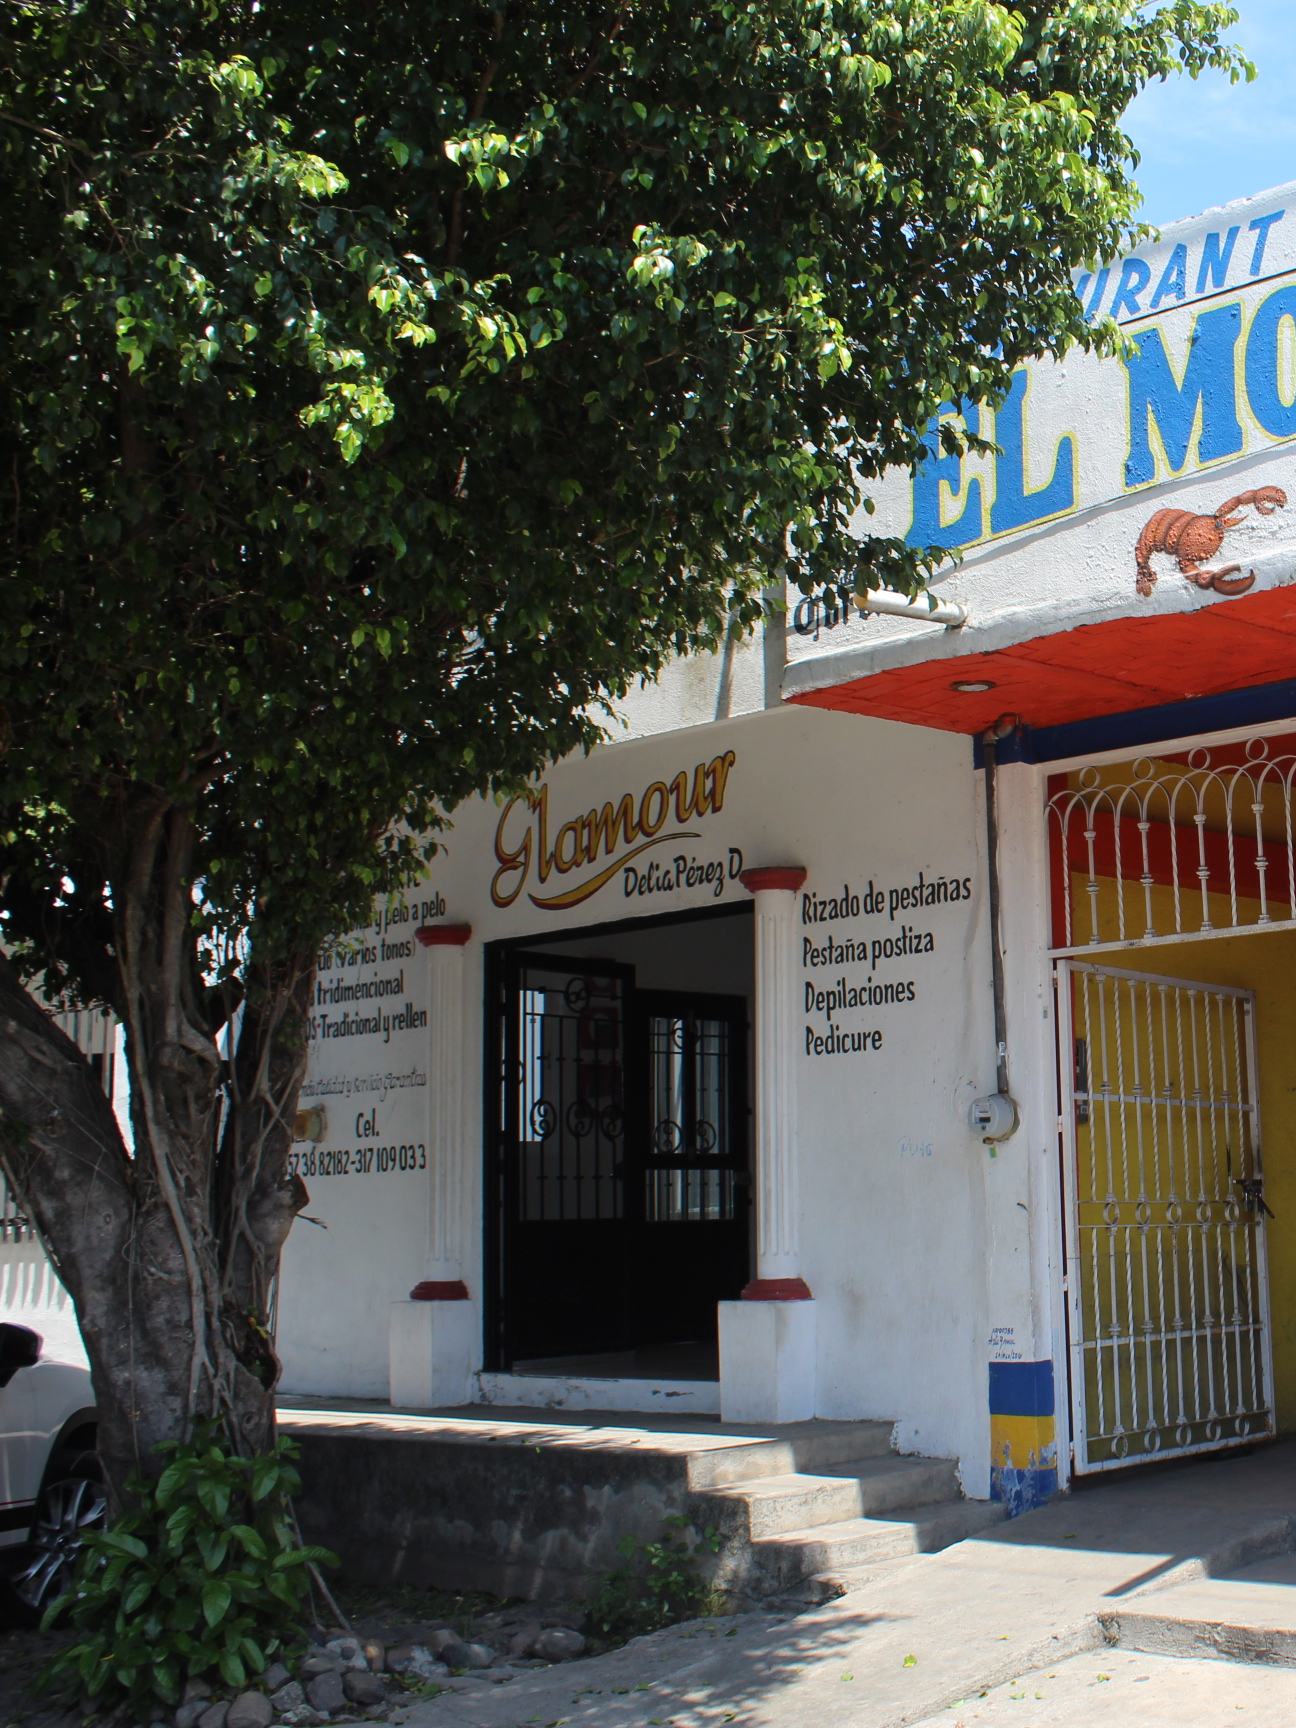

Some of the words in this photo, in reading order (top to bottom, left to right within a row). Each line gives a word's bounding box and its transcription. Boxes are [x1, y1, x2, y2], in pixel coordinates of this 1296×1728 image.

[1075, 209, 1286, 323] URANT
[903, 366, 1078, 558] EL
[490, 750, 736, 909] Glamour
[624, 861, 674, 898] Delia
[673, 853, 727, 898] Pérez
[802, 884, 860, 925] Rizado
[864, 880, 885, 916] de
[888, 871, 972, 921] pestañas
[412, 903, 420, 921] a
[421, 890, 446, 926] pelo
[803, 935, 868, 968] Pestaña
[871, 925, 935, 971] postiza
[316, 968, 404, 1006] tridimencional
[804, 976, 916, 1021] Depilaciones
[383, 1010, 391, 1044] y
[805, 1023, 883, 1056] Pedicure
[355, 1107, 381, 1139] Cel.
